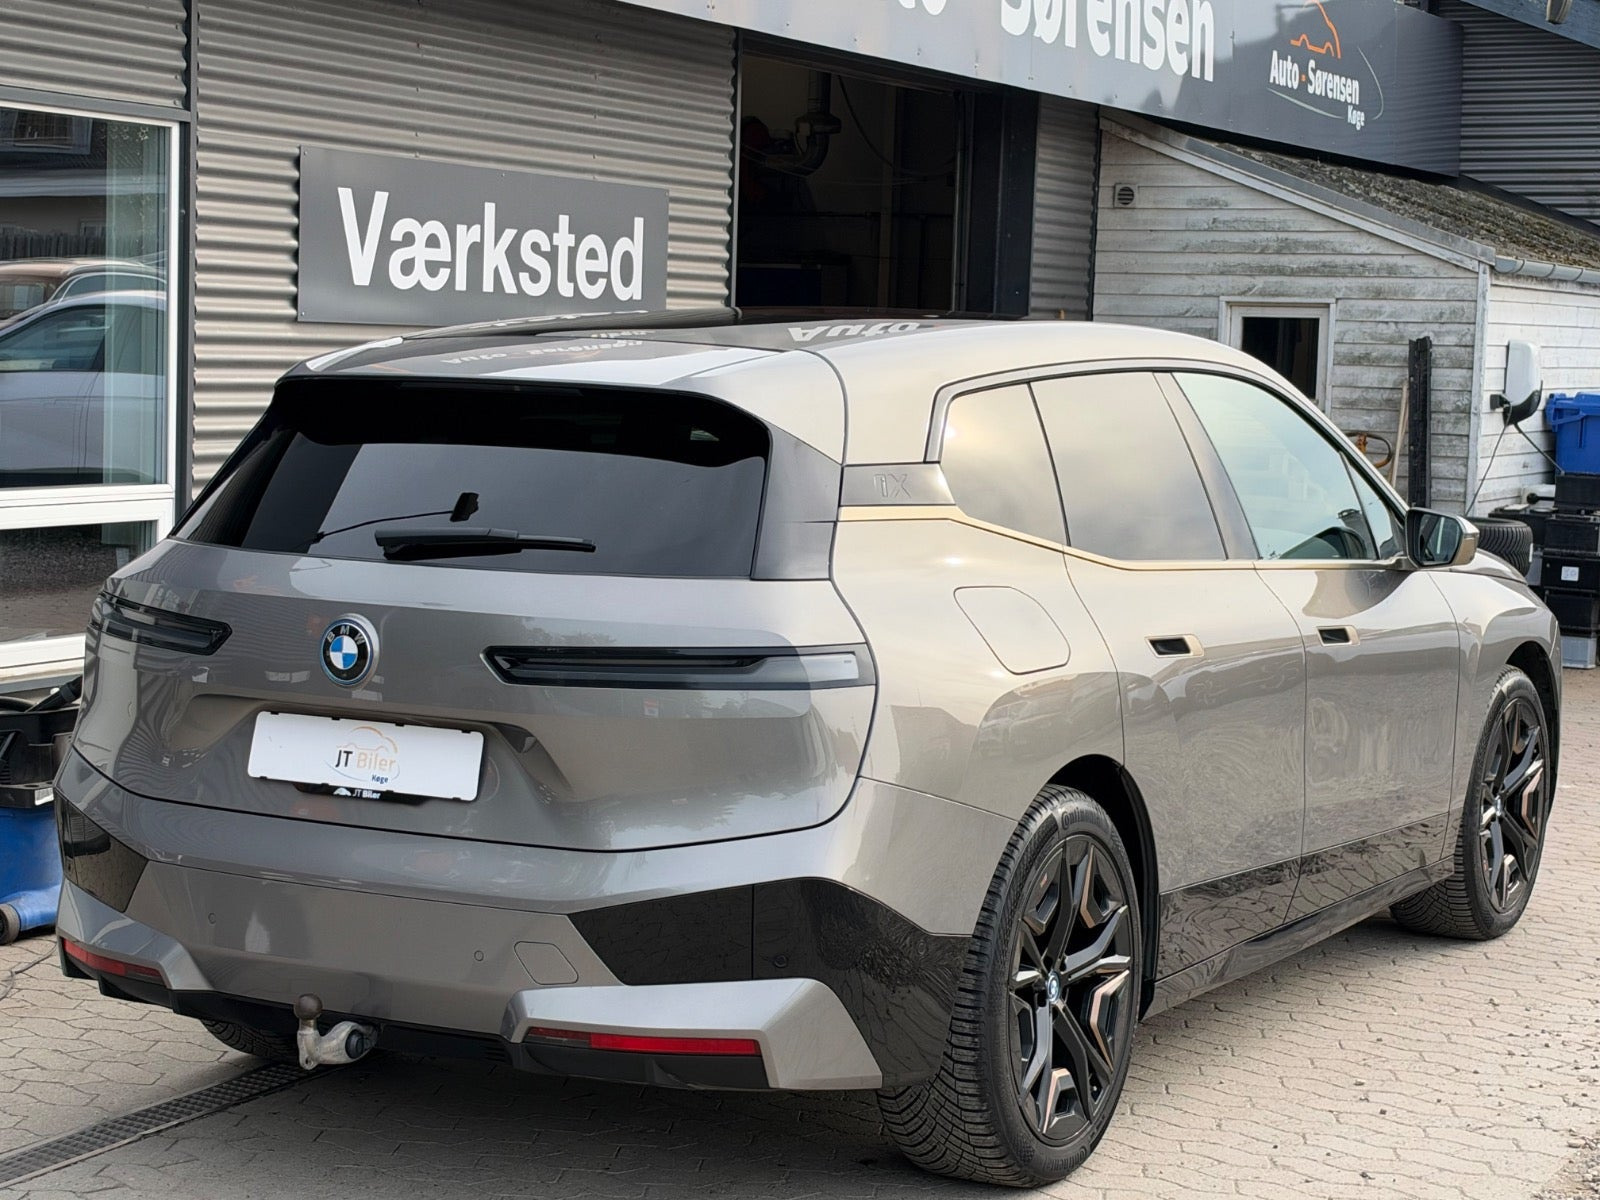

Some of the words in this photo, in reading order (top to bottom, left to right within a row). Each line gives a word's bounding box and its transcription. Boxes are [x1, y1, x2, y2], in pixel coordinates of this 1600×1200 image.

[1269, 50, 1299, 90] Auto
[1307, 59, 1360, 105] Sørensen
[1347, 105, 1365, 130] Køge
[337, 187, 644, 301] Værksted
[326, 625, 367, 645] BMW
[335, 749, 354, 768] JT
[356, 751, 397, 771] Biler
